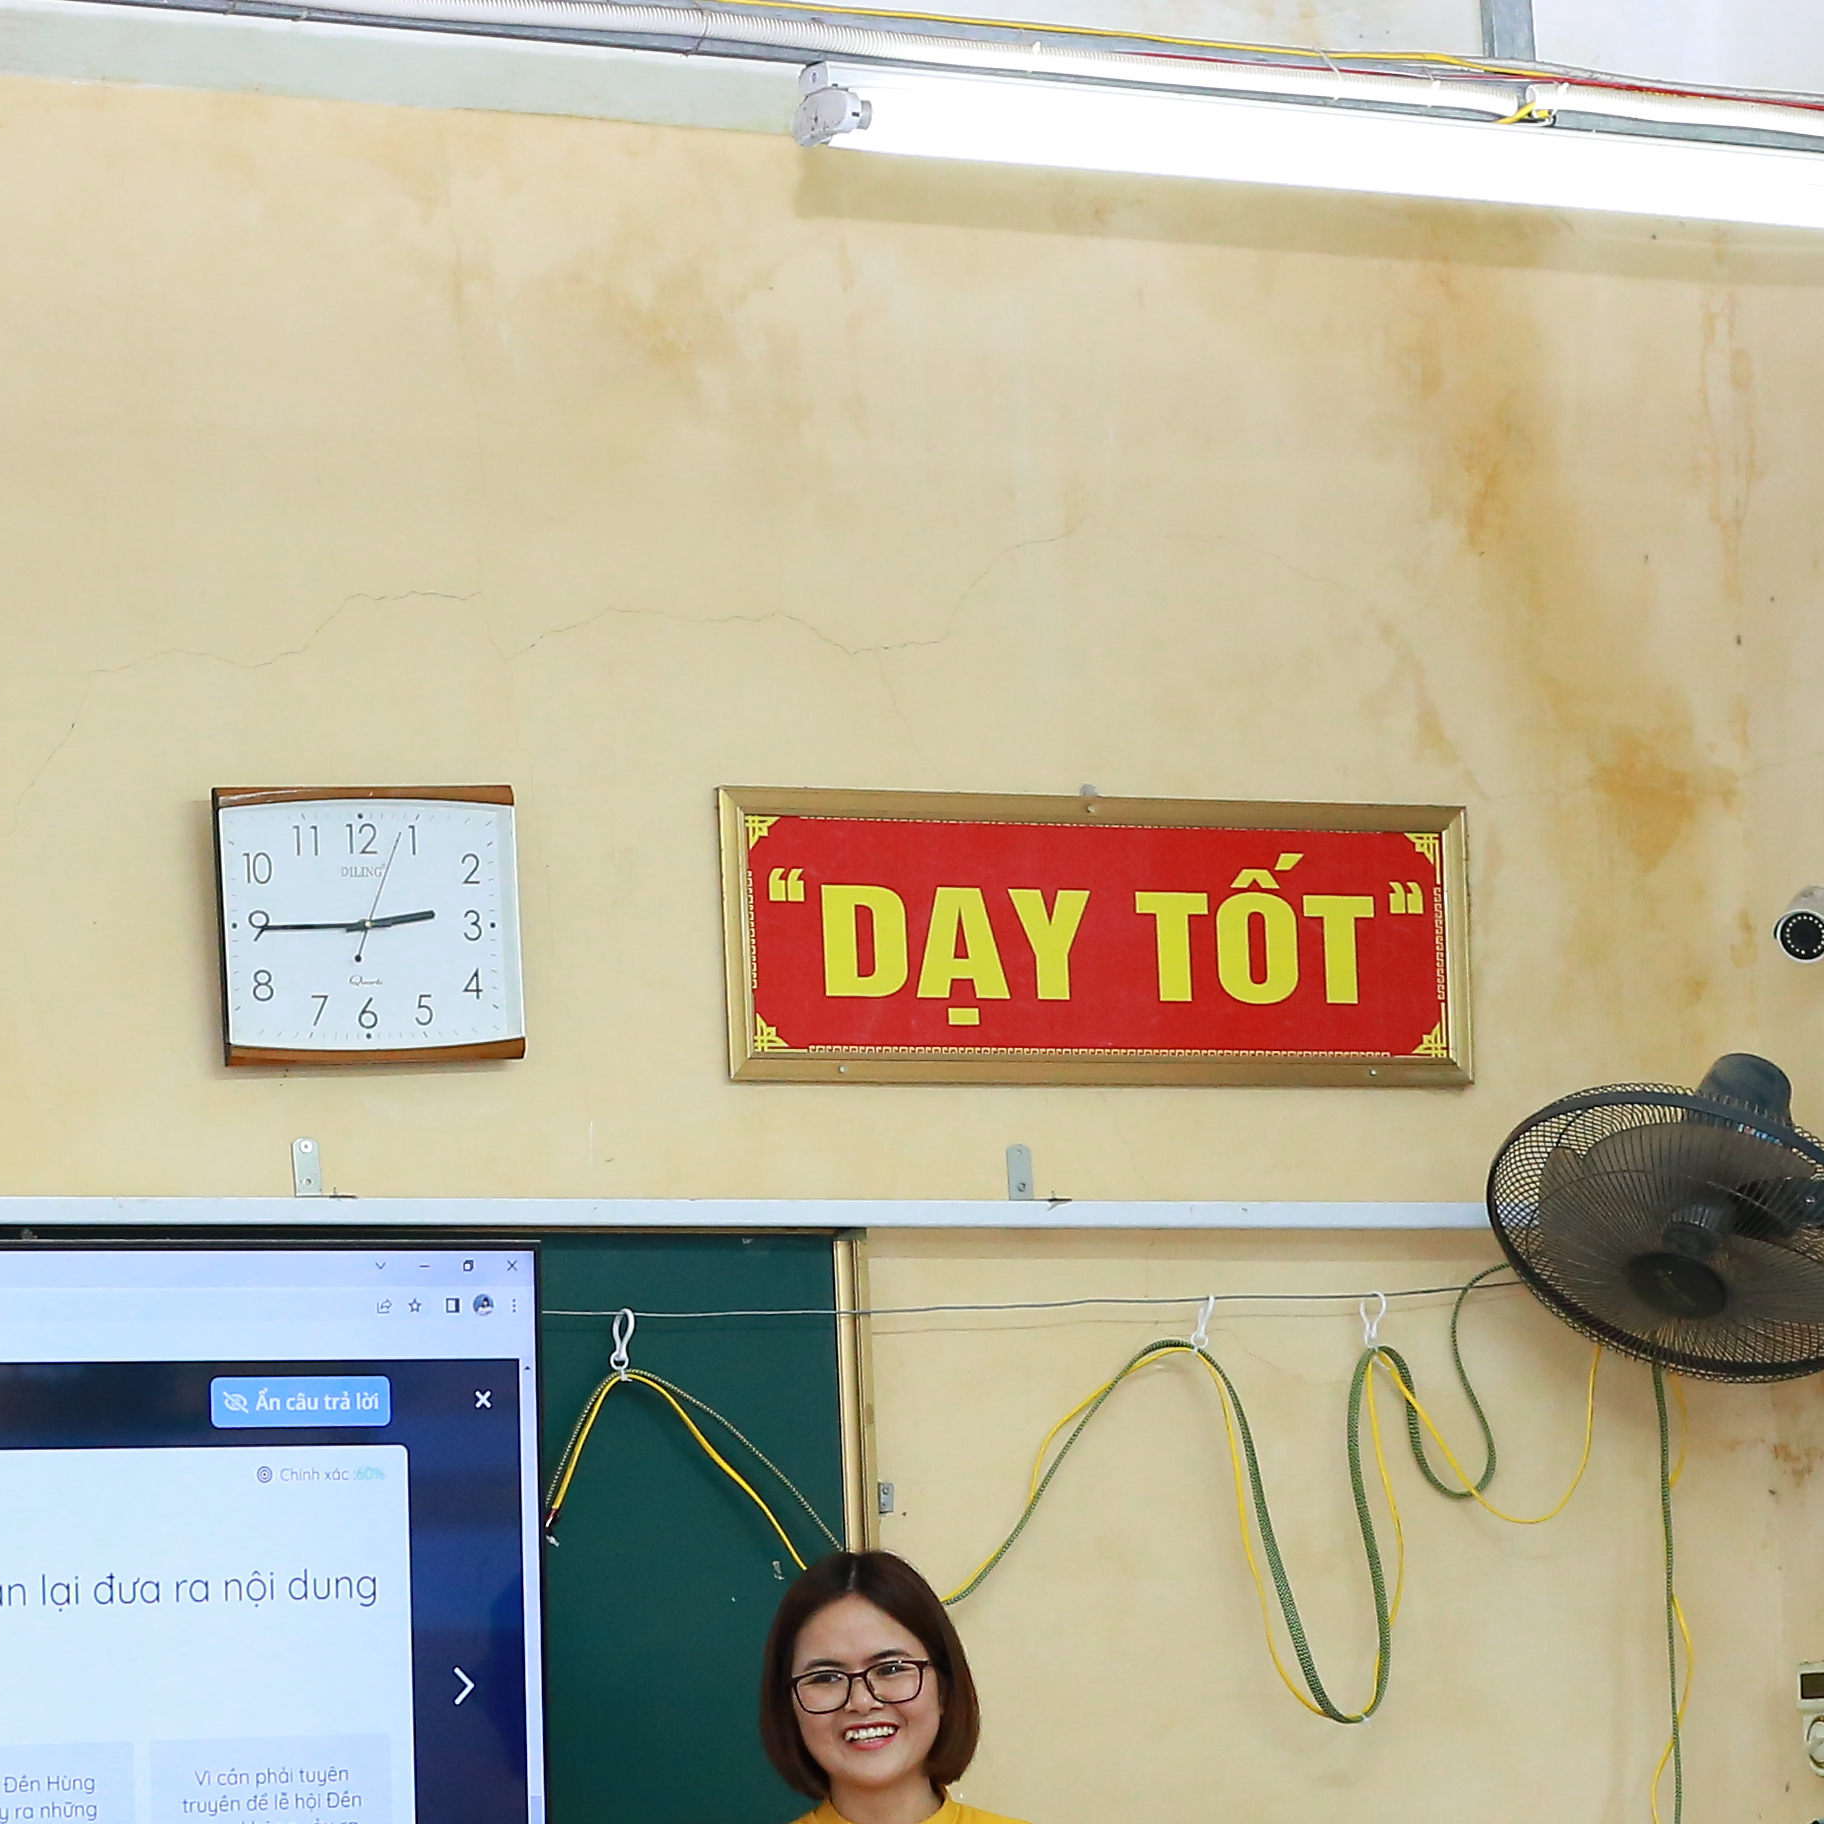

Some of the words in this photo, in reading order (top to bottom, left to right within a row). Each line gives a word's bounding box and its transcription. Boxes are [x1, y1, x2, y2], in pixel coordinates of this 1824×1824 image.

[292, 825, 320, 856] 11
[344, 823, 378, 854] 12
[408, 825, 416, 856] 1
[242, 852, 272, 884] 10
[341, 866, 383, 878] DILING
[461, 853, 481, 884] 2
[248, 910, 270, 942] 9
[463, 910, 482, 941] 3
[252, 969, 274, 1001] 8
[462, 968, 483, 1000] 4
[311, 995, 329, 1026] 7
[358, 997, 378, 1029] 6
[415, 995, 433, 1025] 5
[255, 1388, 280, 1411] Ẩn
[286, 1393, 318, 1411] câu
[324, 1391, 351, 1410] trả
[356, 1392, 379, 1410] lời
[325, 1467, 349, 1481] xác
[41, 1574, 79, 1612] lại
[93, 1573, 161, 1606] đưa
[175, 1579, 209, 1602] ra
[224, 1570, 274, 1608] nội
[288, 1569, 378, 1607] dung
[47, 1775, 95, 1794] Hùng
[15, 1806, 34, 1820] ra
[40, 1802, 97, 1820] những
